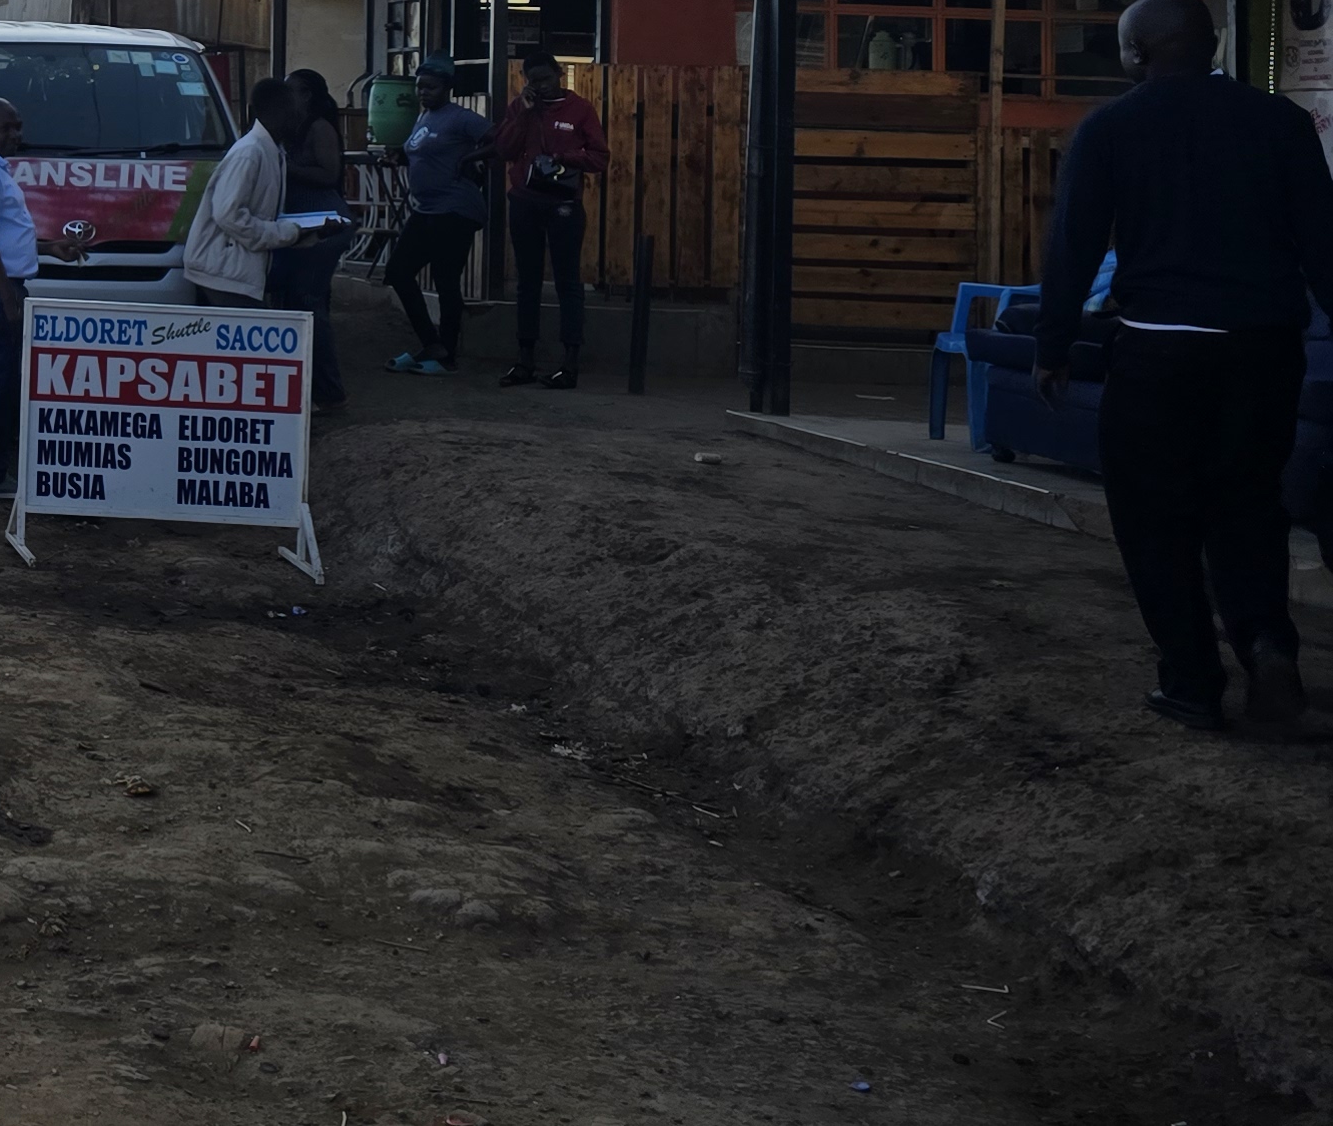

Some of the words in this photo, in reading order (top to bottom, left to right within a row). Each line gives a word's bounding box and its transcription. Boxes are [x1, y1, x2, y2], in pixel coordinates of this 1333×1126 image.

[11, 161, 187, 191] ANSLINE
[33, 314, 148, 346] ELDORET
[151, 317, 212, 345] Shuttle
[216, 324, 298, 354] SACCO
[37, 353, 298, 408] KAPSABET
[38, 408, 163, 440] KAKAMEGA
[178, 414, 275, 445] ELDORET
[37, 439, 131, 470] MUMIAS
[177, 447, 293, 479] BUNGOMA
[36, 471, 105, 500] BUSIA
[176, 478, 270, 509] MALABA
